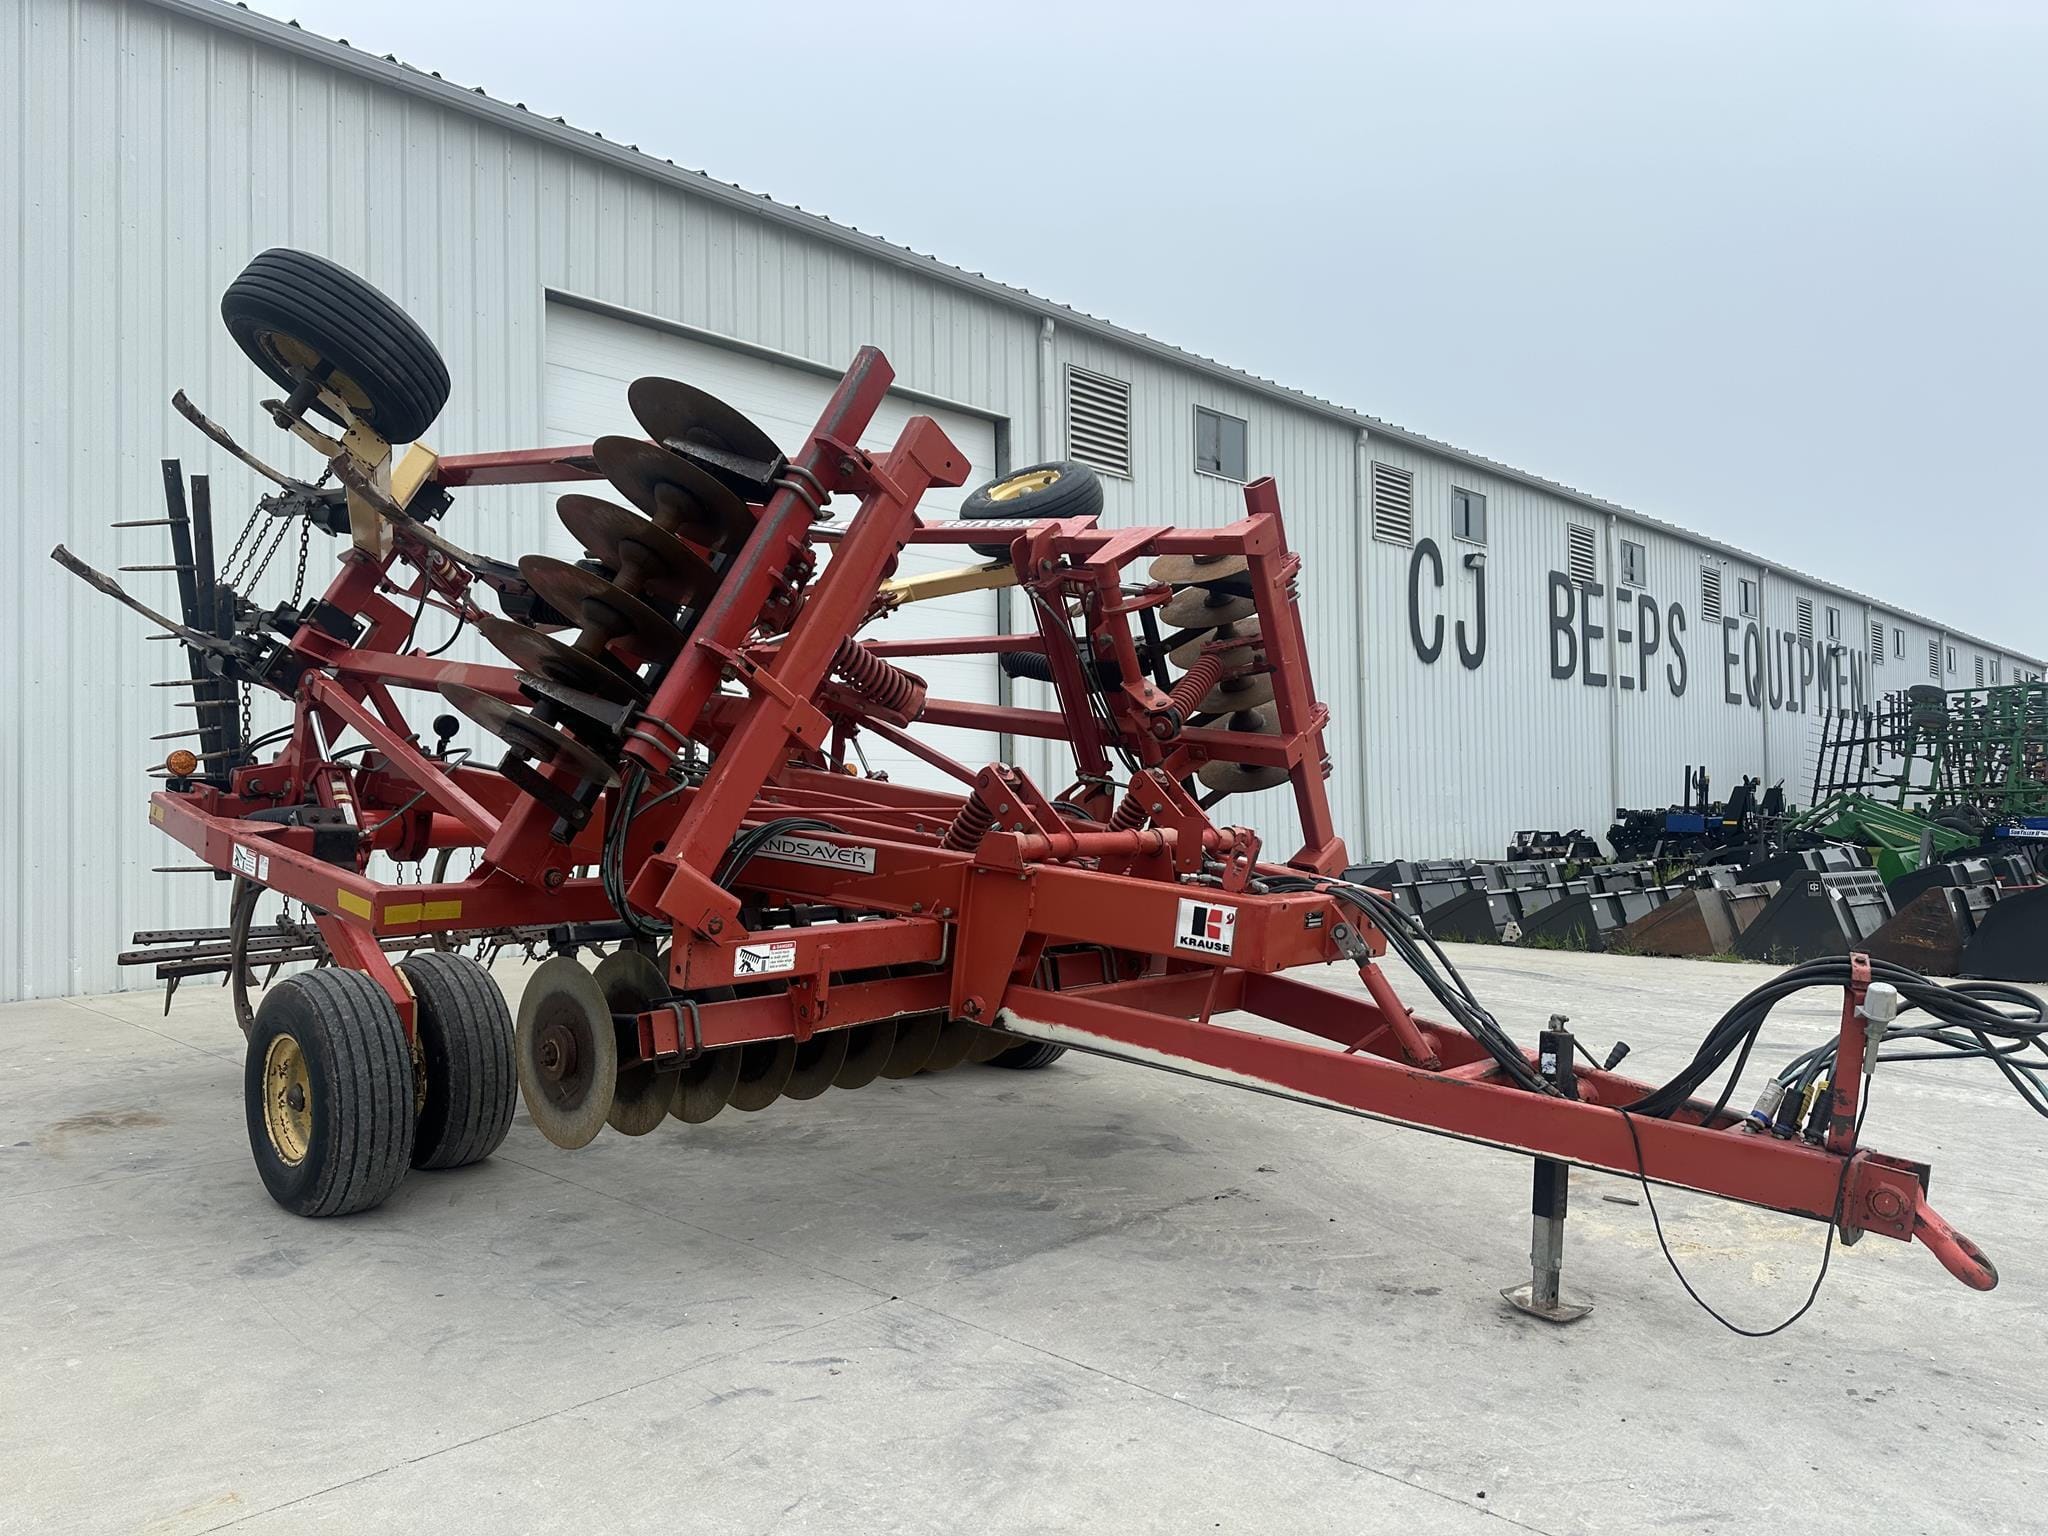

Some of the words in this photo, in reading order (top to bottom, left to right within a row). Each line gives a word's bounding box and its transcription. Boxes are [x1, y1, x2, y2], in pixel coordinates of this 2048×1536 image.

[1409, 537, 1487, 670] CJ
[1549, 569, 1687, 698] BEEPS
[1723, 616, 1877, 721] EQUIPMEN
[1180, 936, 1230, 952] KRAUSE
